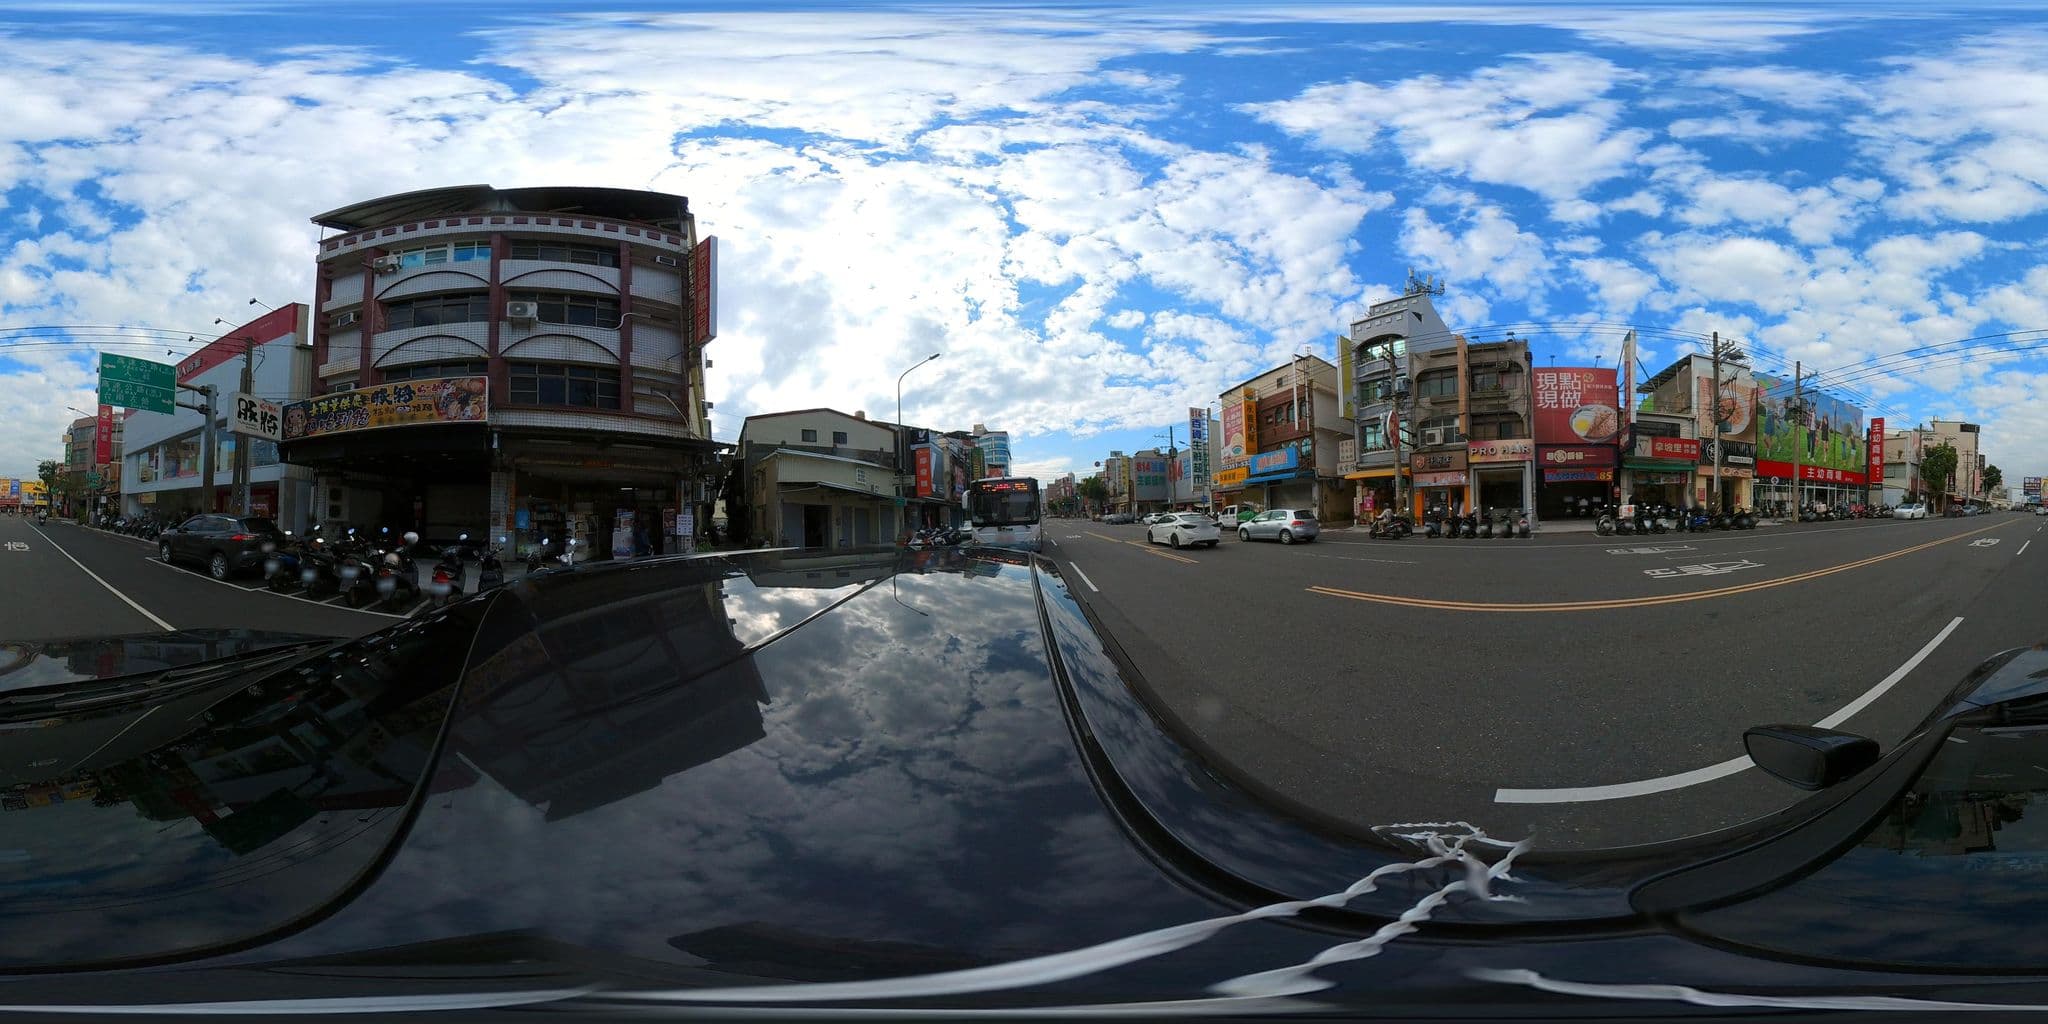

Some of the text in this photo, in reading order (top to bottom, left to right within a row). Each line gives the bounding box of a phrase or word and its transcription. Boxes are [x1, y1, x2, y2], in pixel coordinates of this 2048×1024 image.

[1536, 373, 1582, 390] 現點
[1537, 390, 1582, 409] 現做
[237, 397, 279, 436] 豚將
[1470, 445, 1530, 456] PRO HAIR
[1599, 471, 1613, 481] 85
[1642, 559, 1767, 579] 慢
